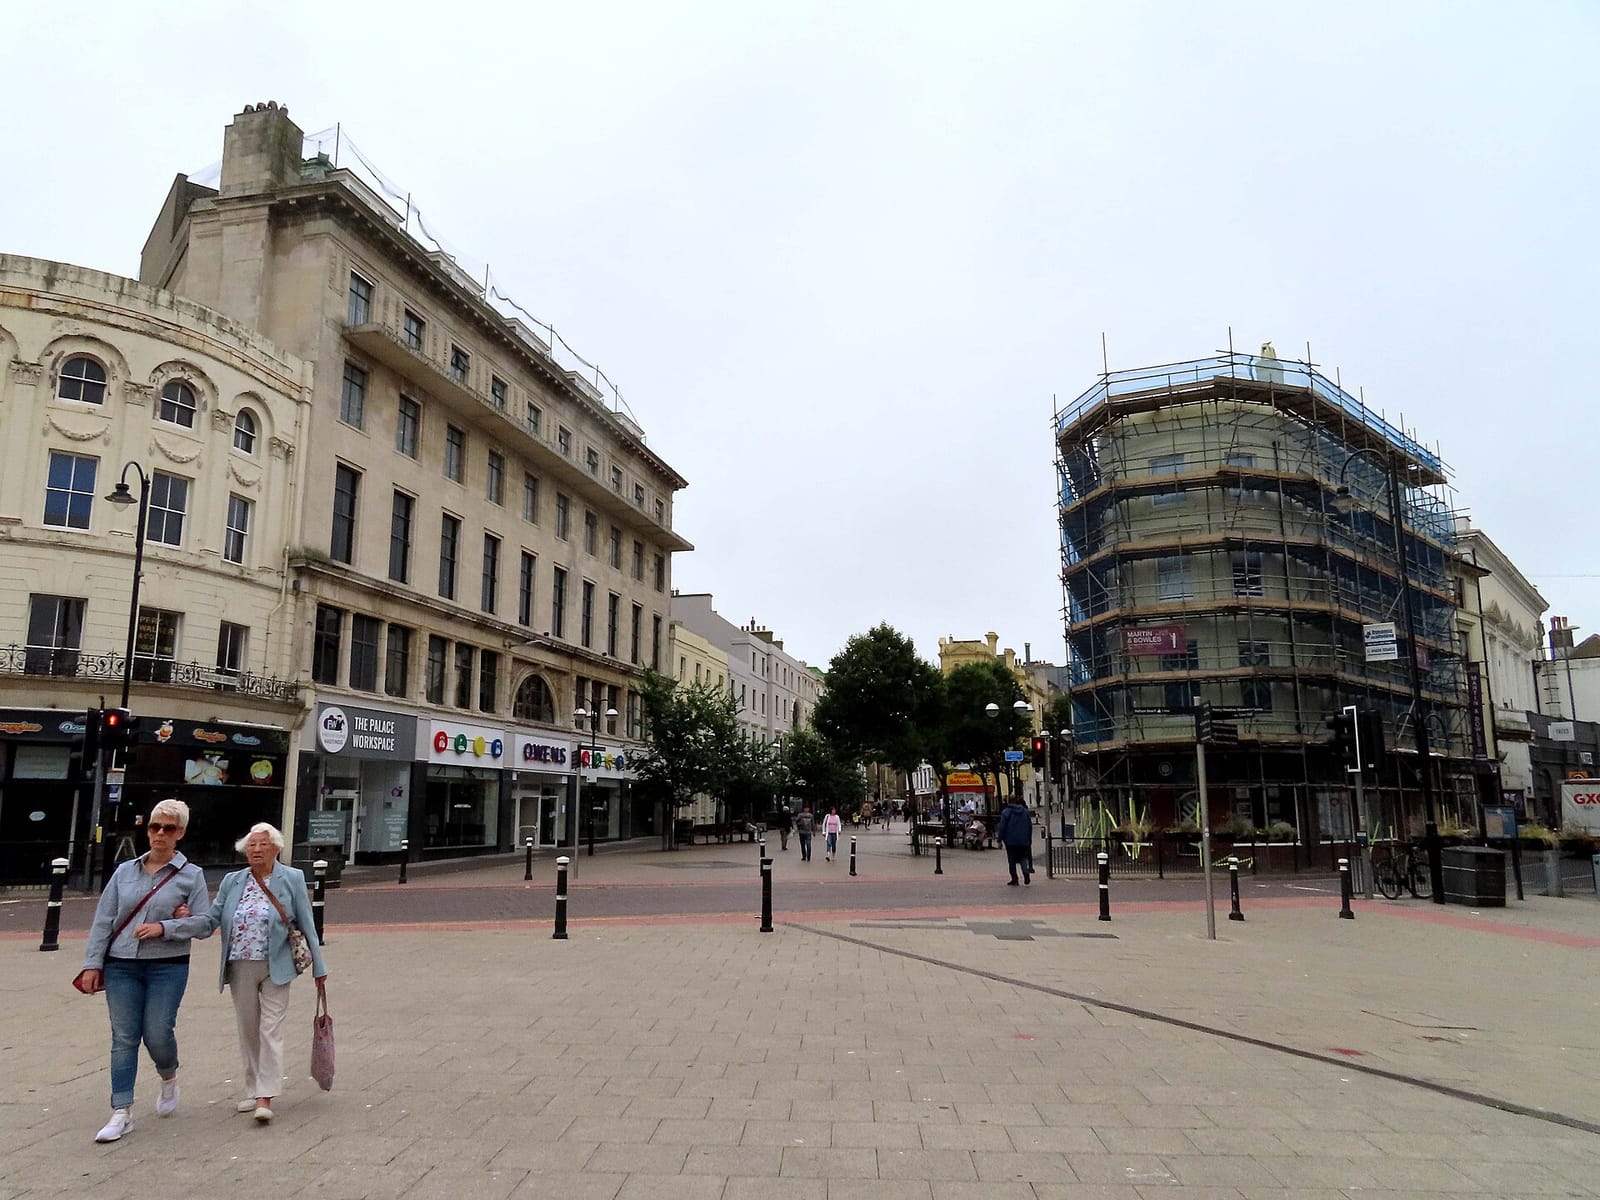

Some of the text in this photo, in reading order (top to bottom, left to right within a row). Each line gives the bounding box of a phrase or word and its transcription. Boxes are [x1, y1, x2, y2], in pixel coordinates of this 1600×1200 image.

[1127, 630, 1153, 638] MARTIN
[1134, 636, 1163, 644] BOWLES
[354, 716, 395, 734] THE PALACE
[352, 734, 395, 751] WORKSPACE
[523, 743, 567, 765] OWENS
